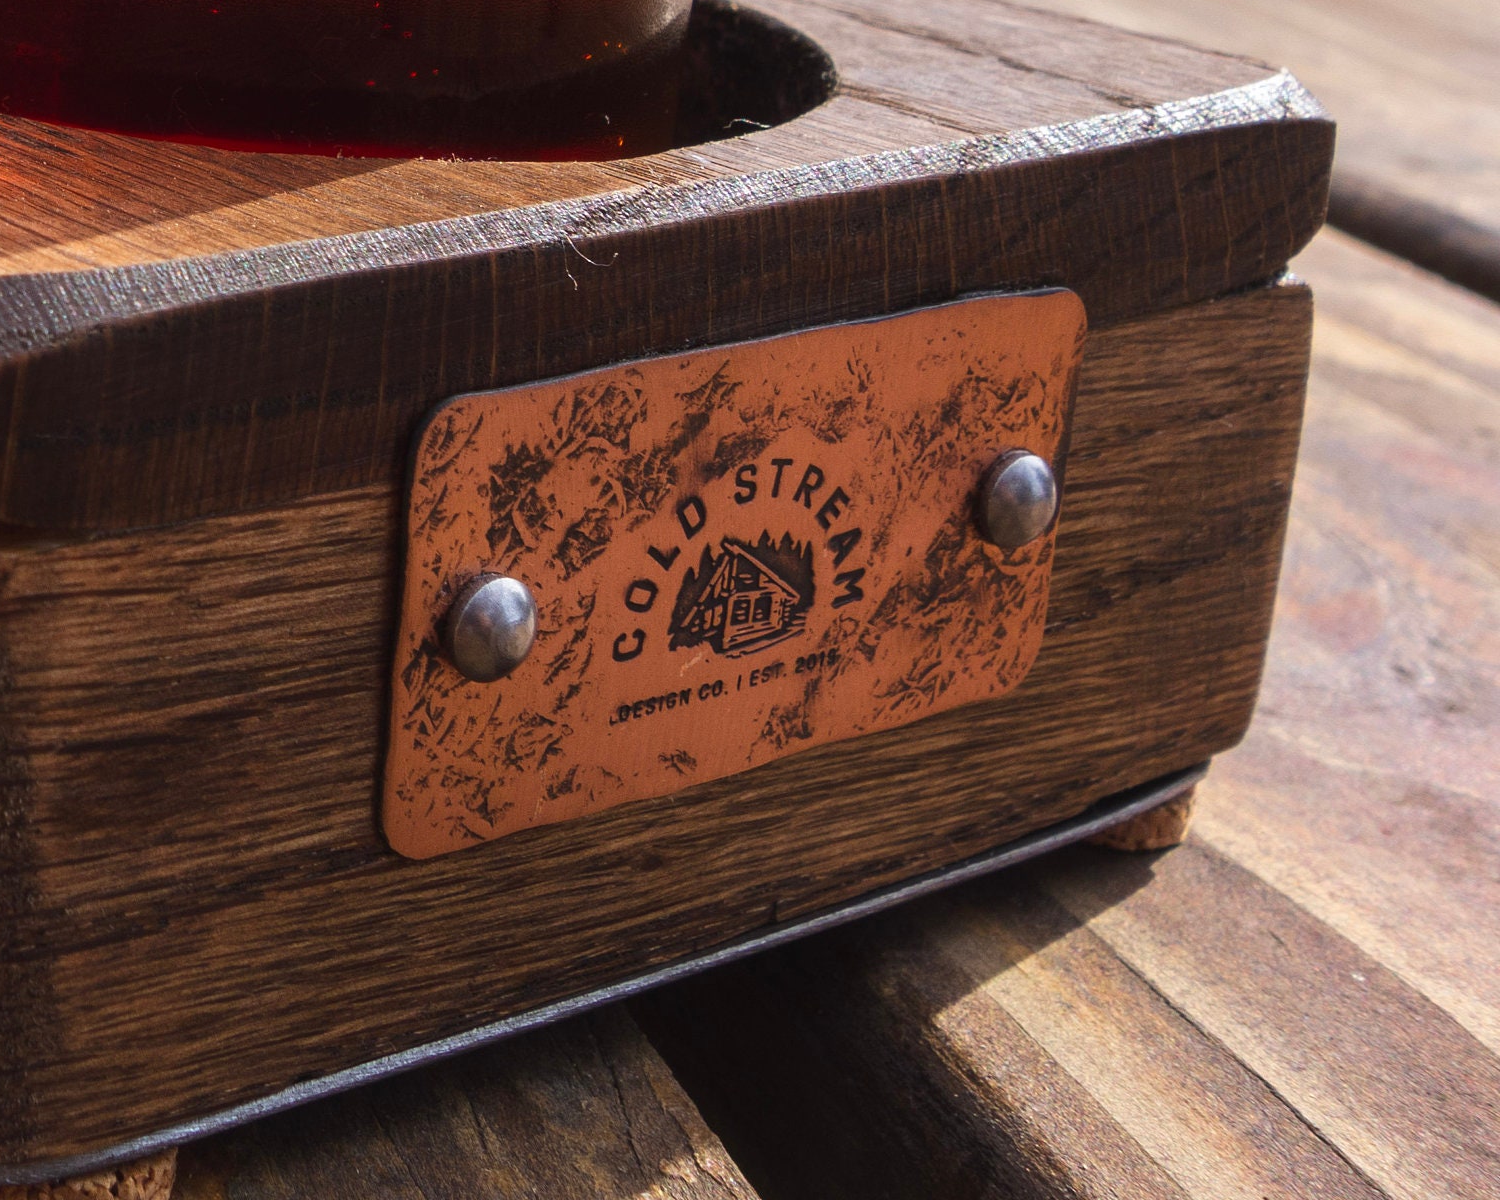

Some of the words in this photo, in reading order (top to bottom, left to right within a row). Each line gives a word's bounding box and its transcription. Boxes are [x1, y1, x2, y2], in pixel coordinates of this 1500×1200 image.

[612, 496, 707, 662] COLD
[734, 458, 866, 609] STREAM
[615, 687, 692, 723] DESIGN
[698, 679, 728, 701] CO.
[749, 661, 787, 688] EST.
